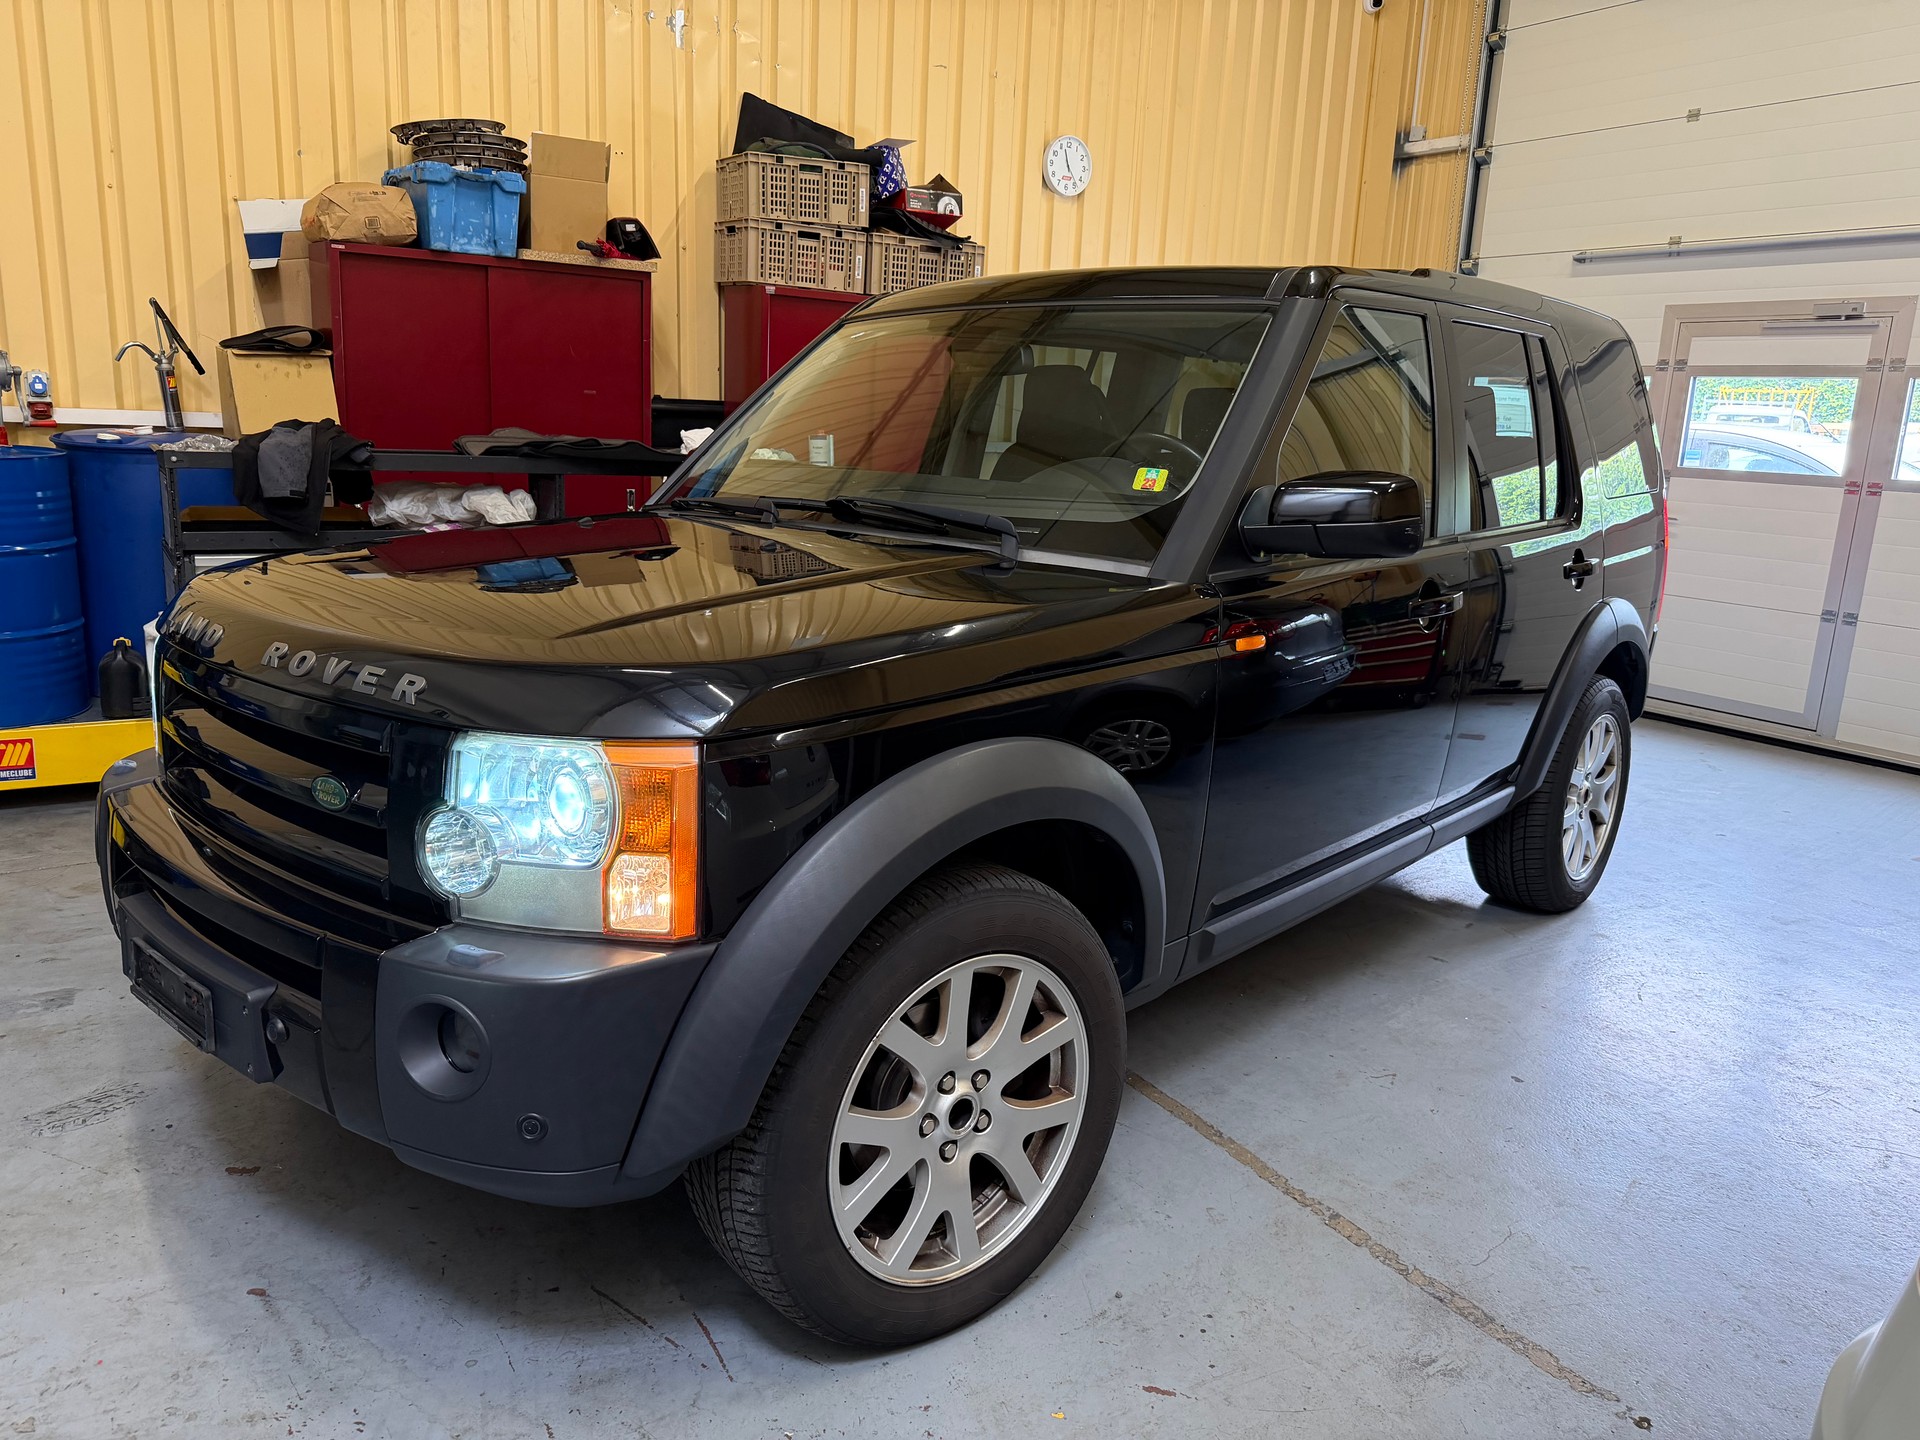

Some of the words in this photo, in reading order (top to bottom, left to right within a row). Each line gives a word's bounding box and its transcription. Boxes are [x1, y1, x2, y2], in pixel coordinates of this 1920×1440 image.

[1080, 154, 1085, 162] 2
[1049, 159, 1054, 167] 9
[1082, 165, 1086, 173] 3
[1051, 170, 1056, 178] 8
[1064, 183, 1068, 191] 6
[1141, 478, 1157, 490] 23
[260, 641, 428, 706] ROVER
[0, 769, 33, 777] MECLUBE
[318, 790, 340, 805] ROVER
